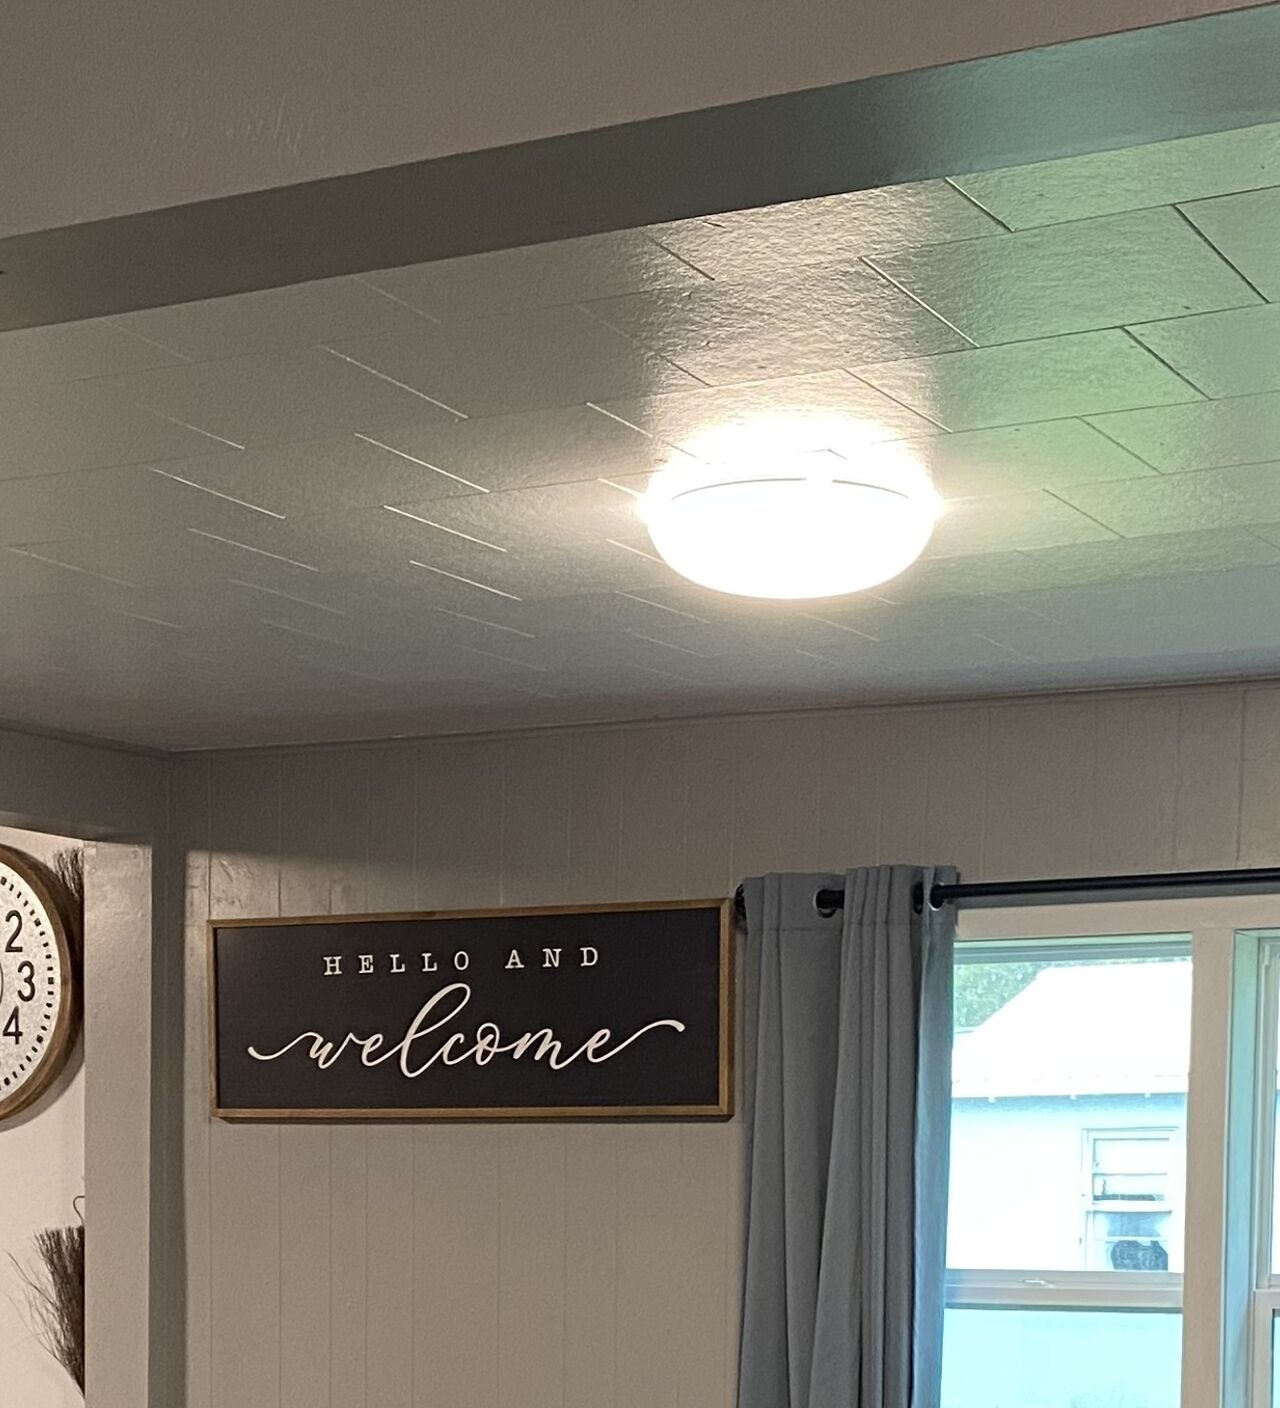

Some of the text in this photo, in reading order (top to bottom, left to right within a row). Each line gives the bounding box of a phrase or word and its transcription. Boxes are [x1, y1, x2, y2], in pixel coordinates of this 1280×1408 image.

[5, 910, 23, 952] 2
[17, 960, 35, 1002] 3
[323, 946, 600, 976] HELLO AND
[2, 1005, 23, 1045] 4
[247, 982, 685, 1079] welcome
